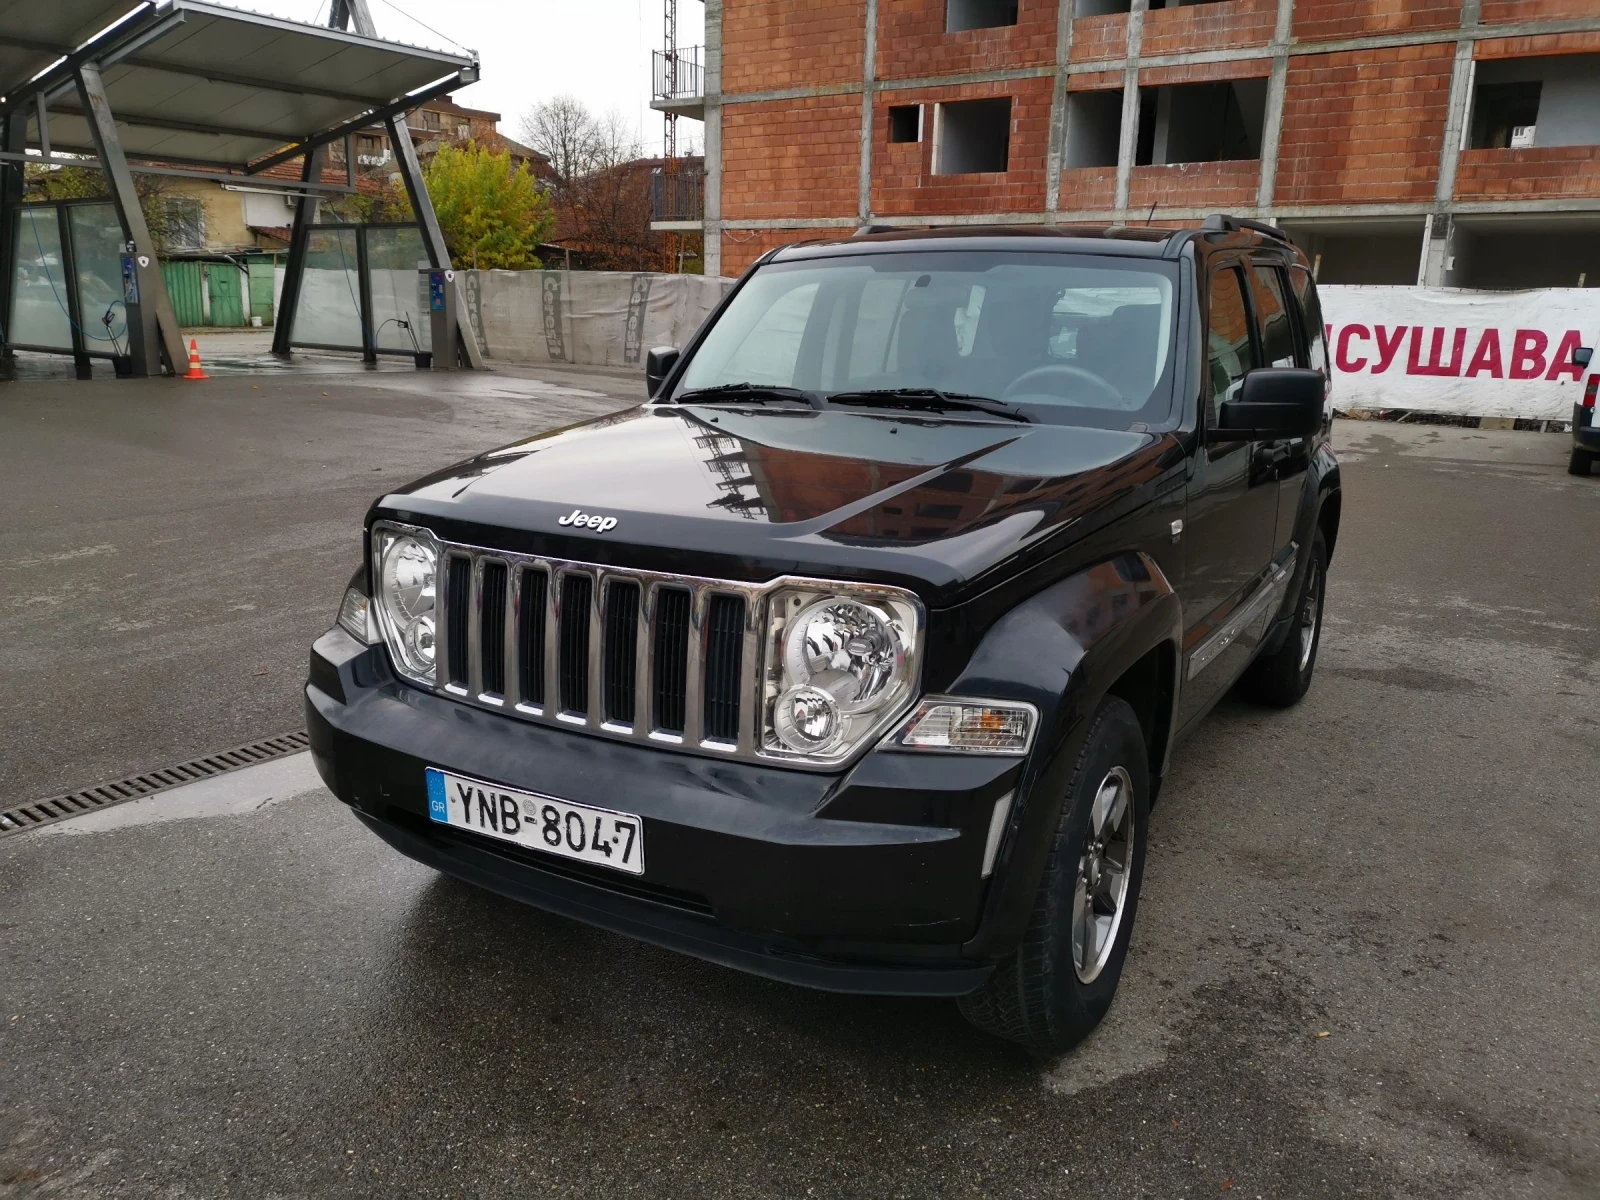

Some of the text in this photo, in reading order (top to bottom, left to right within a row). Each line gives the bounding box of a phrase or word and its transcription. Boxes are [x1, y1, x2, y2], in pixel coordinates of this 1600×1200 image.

[543, 276, 562, 356] Ceresit
[625, 277, 648, 360] Ceresit
[1325, 323, 1584, 381] СУШАВА
[558, 509, 618, 534] Jeep
[431, 800, 446, 814] GR
[456, 782, 637, 864] YNB-8047
